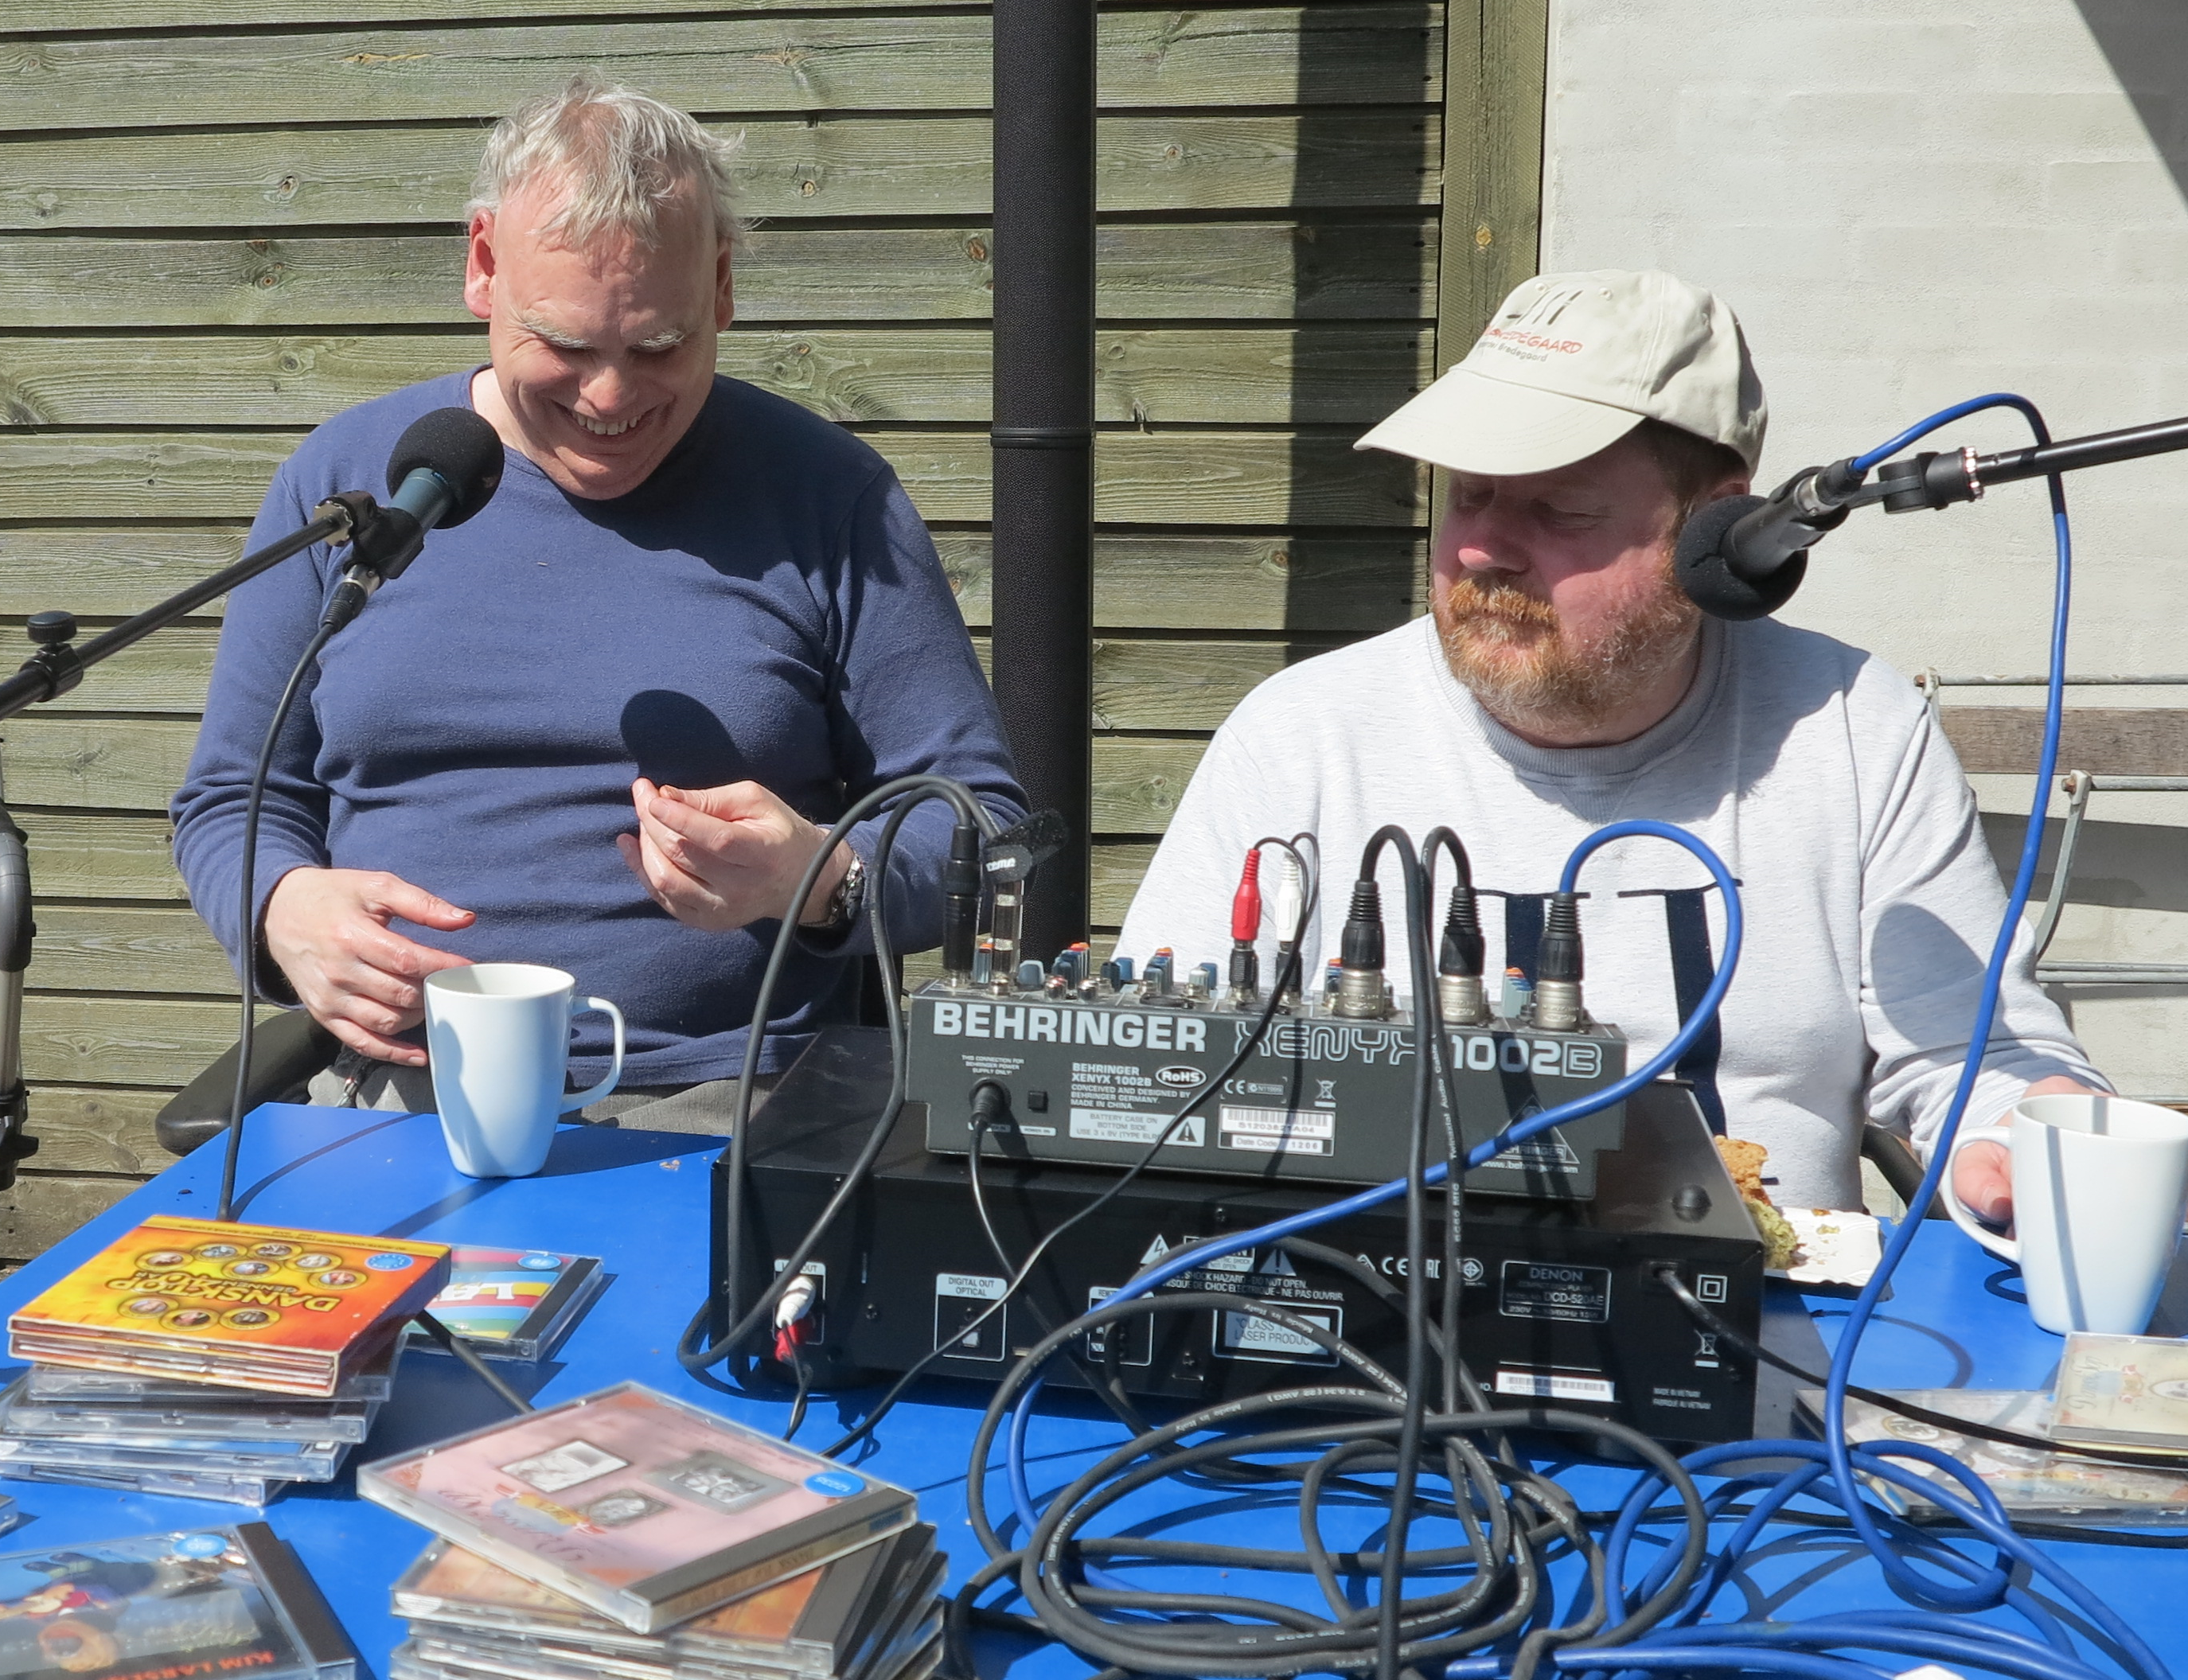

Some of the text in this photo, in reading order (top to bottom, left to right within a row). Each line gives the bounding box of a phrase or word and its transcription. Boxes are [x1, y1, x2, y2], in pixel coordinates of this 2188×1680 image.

[934, 1002, 1603, 1079] BEHRINGER XENYX 1002B
[1071, 1062, 1140, 1076] BEHRINGER
[1071, 1073, 1153, 1087] XENYX 1002B
[1162, 1070, 1200, 1082] RoHS
[1071, 1084, 1116, 1093] CONCEIVED
[1137, 1088, 1177, 1097] DESIGNED
[1071, 1092, 1117, 1101] BEHRINGER
[1090, 1113, 1123, 1122] BATTERY
[1125, 1115, 1145, 1124] CASE
[1076, 1128, 1092, 1136] USE
[1236, 1136, 1255, 1145] Date
[1212, 1273, 1245, 1284] HAZARD
[1265, 1277, 1282, 1287] NOT
[1530, 1267, 1583, 1282] DENON
[948, 1277, 994, 1288] DIGITAL OUT
[106, 1276, 341, 1313] DANSKTOP
[956, 1287, 987, 1296] OPTICAL
[1281, 1288, 1293, 1297] NE
[1294, 1289, 1312, 1299] PAS
[1234, 1328, 1266, 1343] LASER
[218, 1650, 275, 1670] KIM
